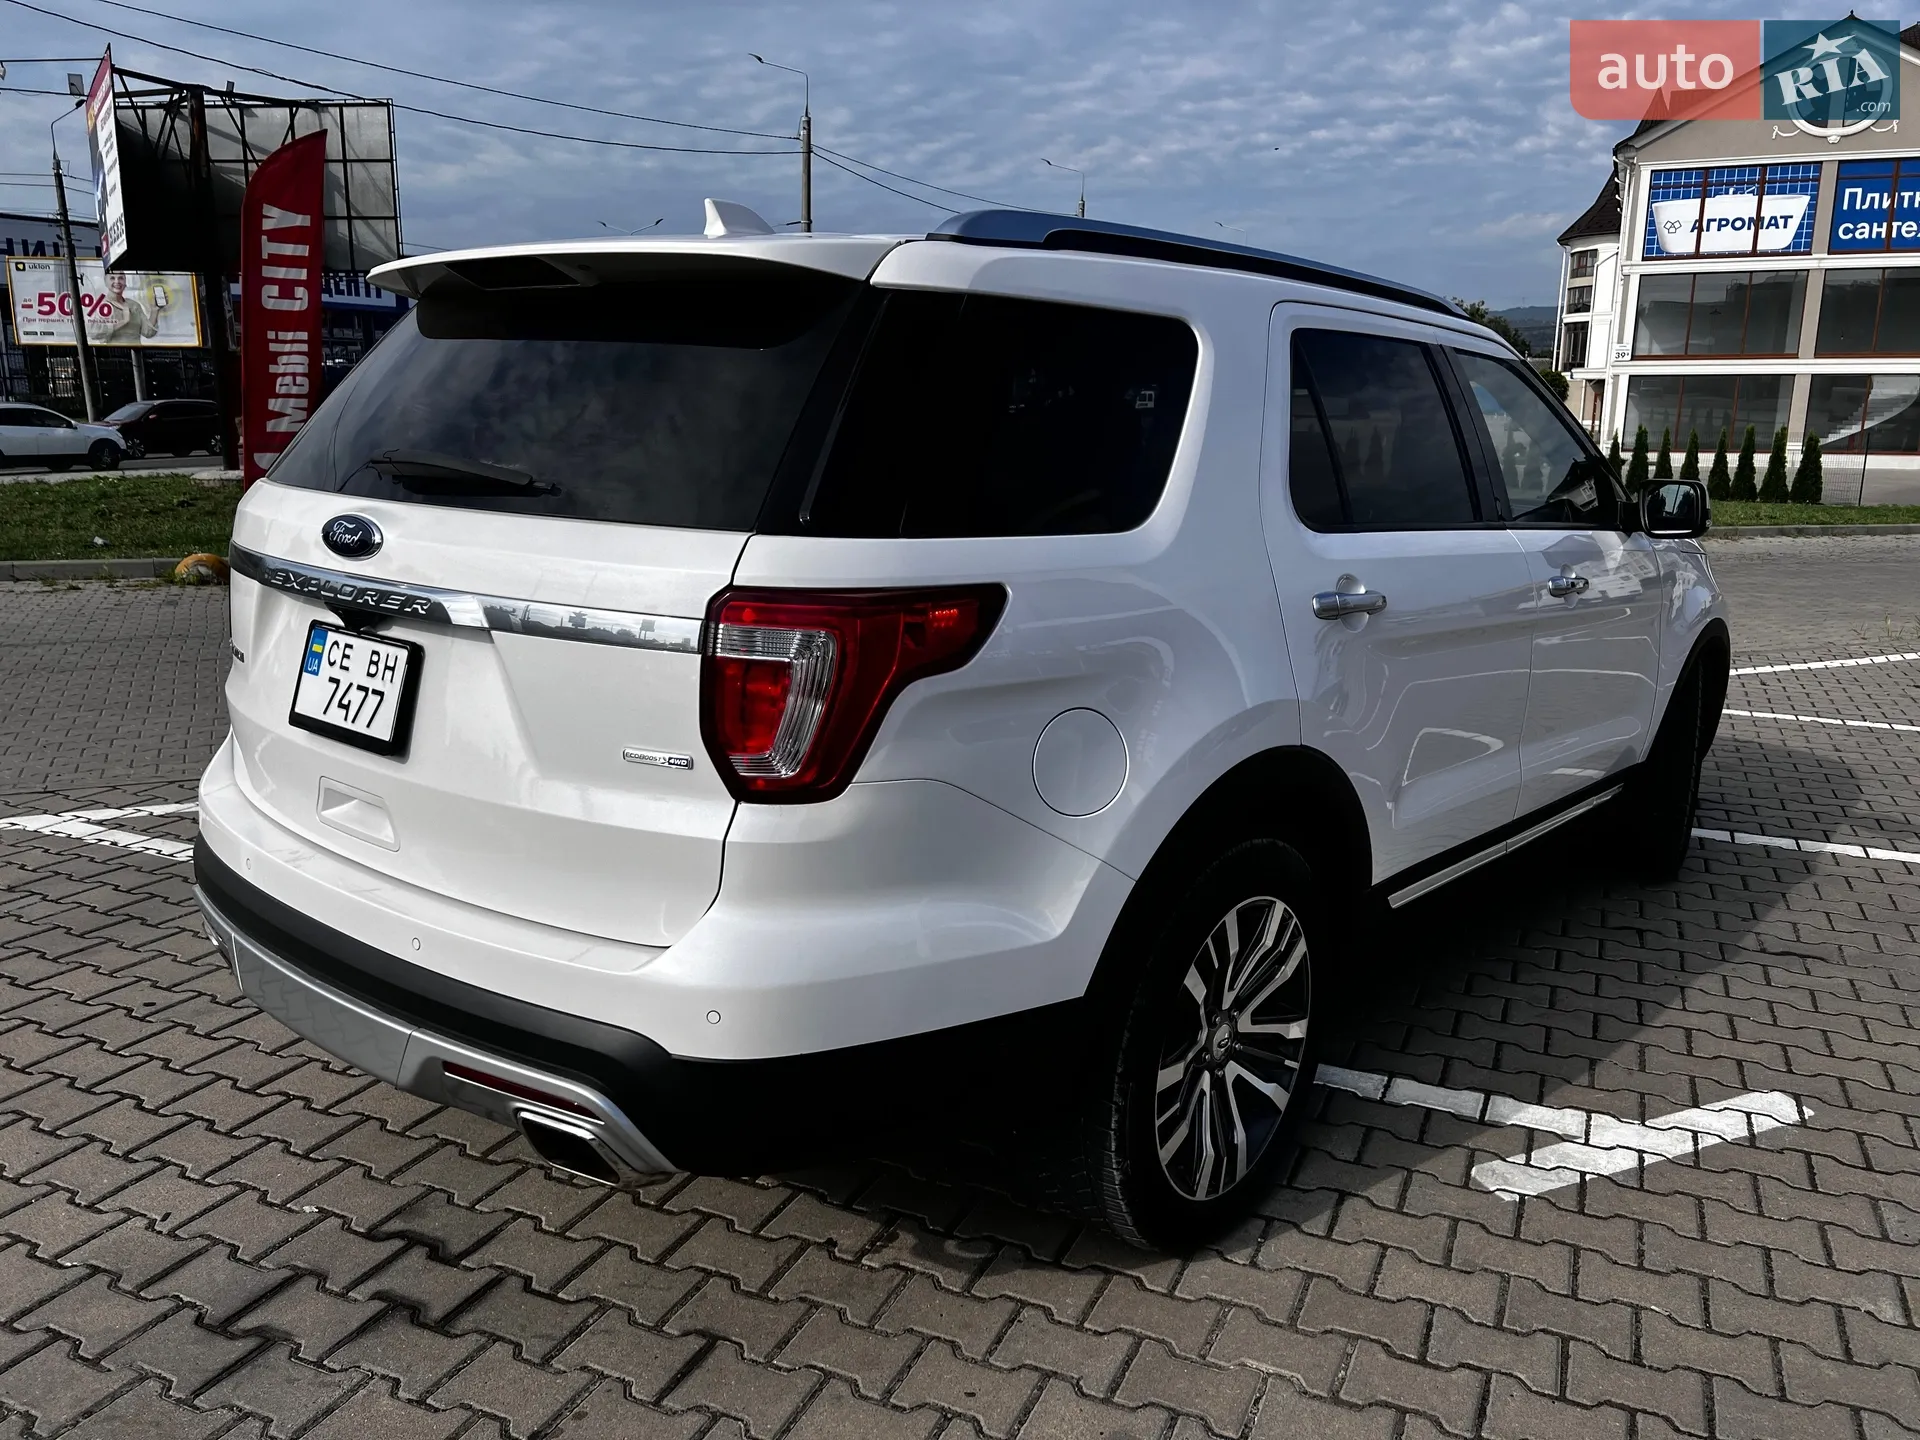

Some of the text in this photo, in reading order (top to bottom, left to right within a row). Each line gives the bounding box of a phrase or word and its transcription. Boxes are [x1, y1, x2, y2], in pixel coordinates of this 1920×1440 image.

[1690, 214, 1794, 233] АГРОМАТ
[1838, 220, 1920, 240] санте
[261, 203, 311, 311] CITY
[21, 292, 113, 318] -50%
[266, 330, 309, 433] Mebli
[328, 520, 362, 547] Ford
[269, 570, 432, 614] EXPLORER
[307, 657, 319, 673] UA
[327, 640, 399, 683] CE BH
[322, 676, 385, 729] 7477
[668, 757, 688, 766] 4WD
